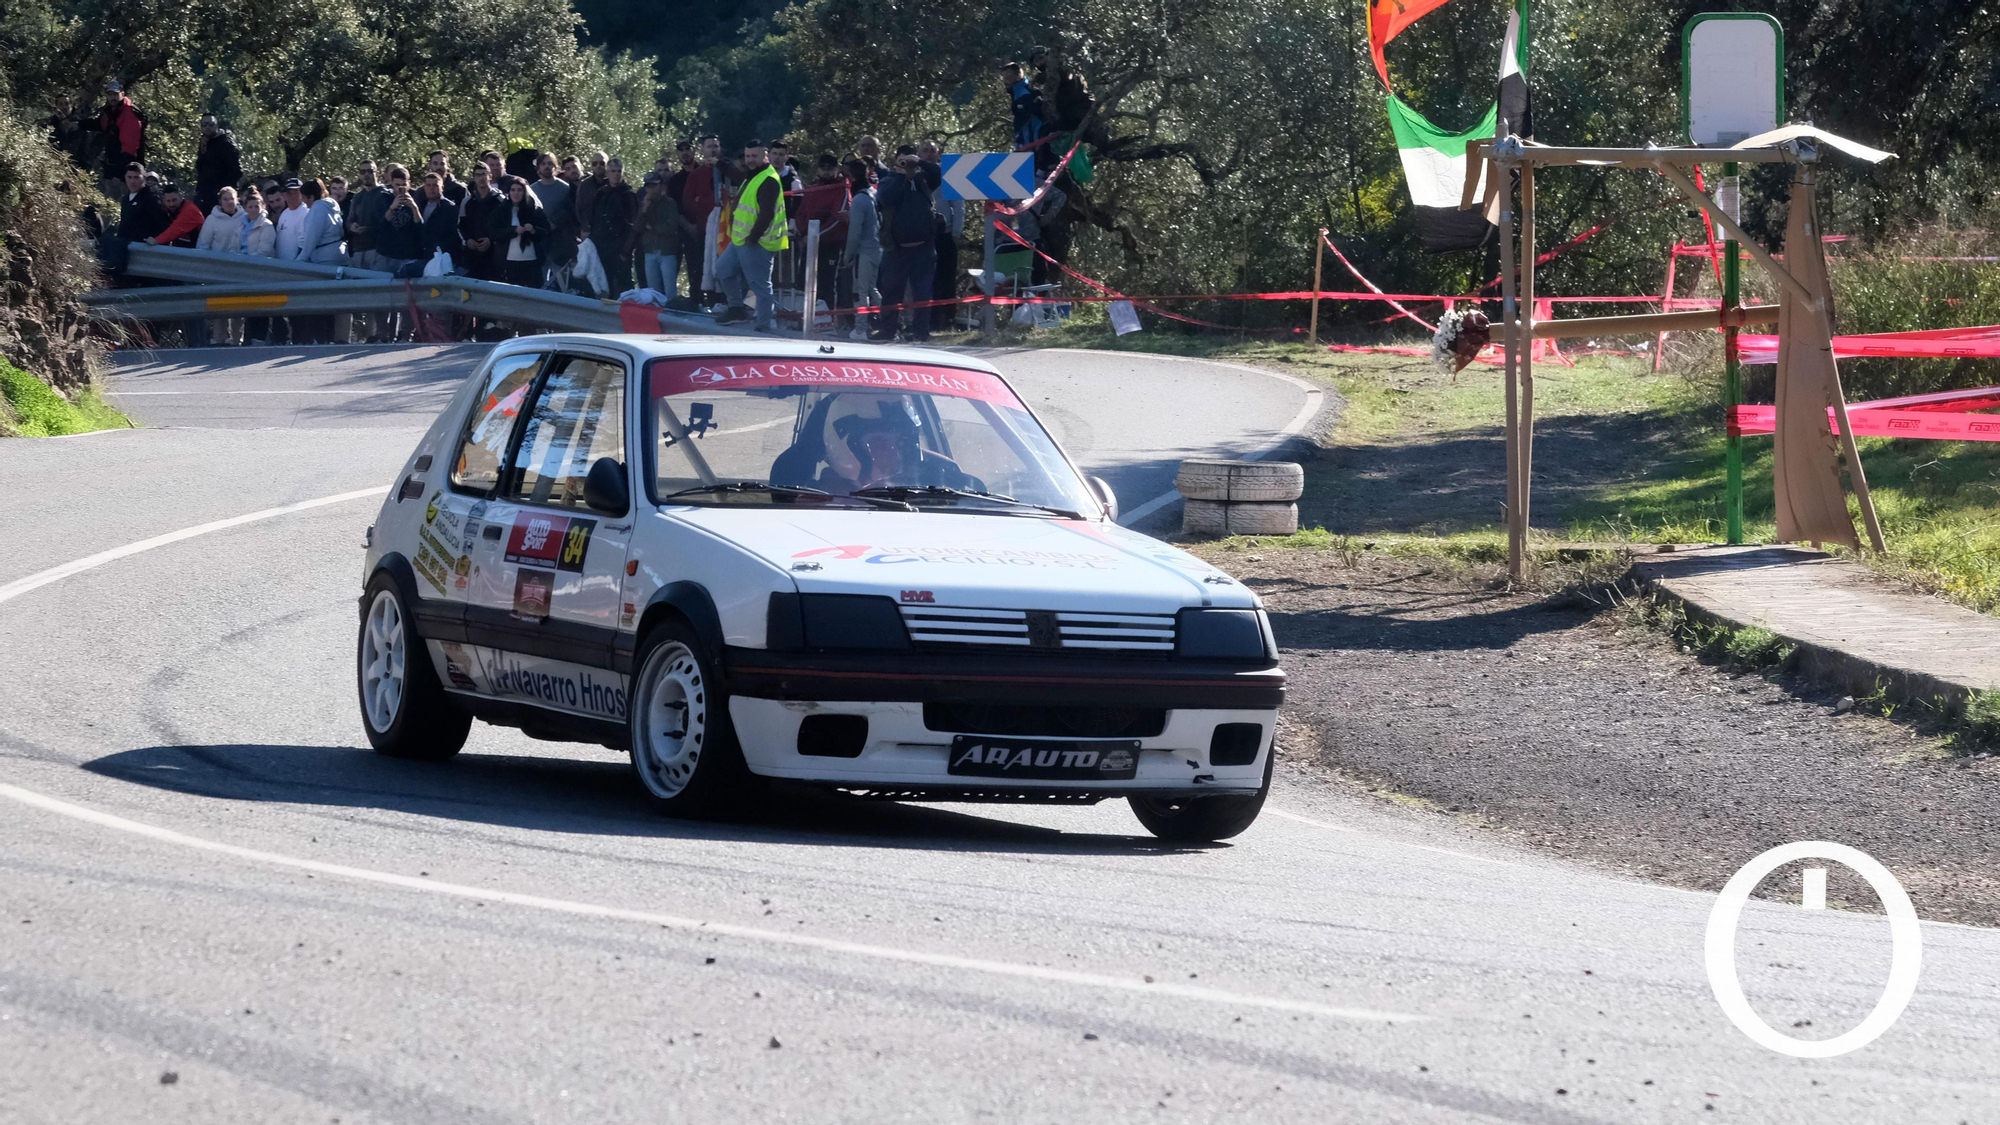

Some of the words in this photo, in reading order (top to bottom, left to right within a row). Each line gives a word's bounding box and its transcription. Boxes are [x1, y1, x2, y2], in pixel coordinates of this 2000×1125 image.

[725, 366, 765, 380] LA
[769, 364, 837, 378] CASA
[841, 366, 876, 380] DE
[876, 367, 970, 392] DURÁN
[526, 518, 552, 538] AUTO
[521, 534, 547, 551] SPORT
[564, 525, 588, 564] 34
[900, 590, 935, 602] MVR
[510, 659, 577, 706] Navarro
[580, 672, 626, 718] Hnos
[953, 744, 1100, 770] ARAUTO
